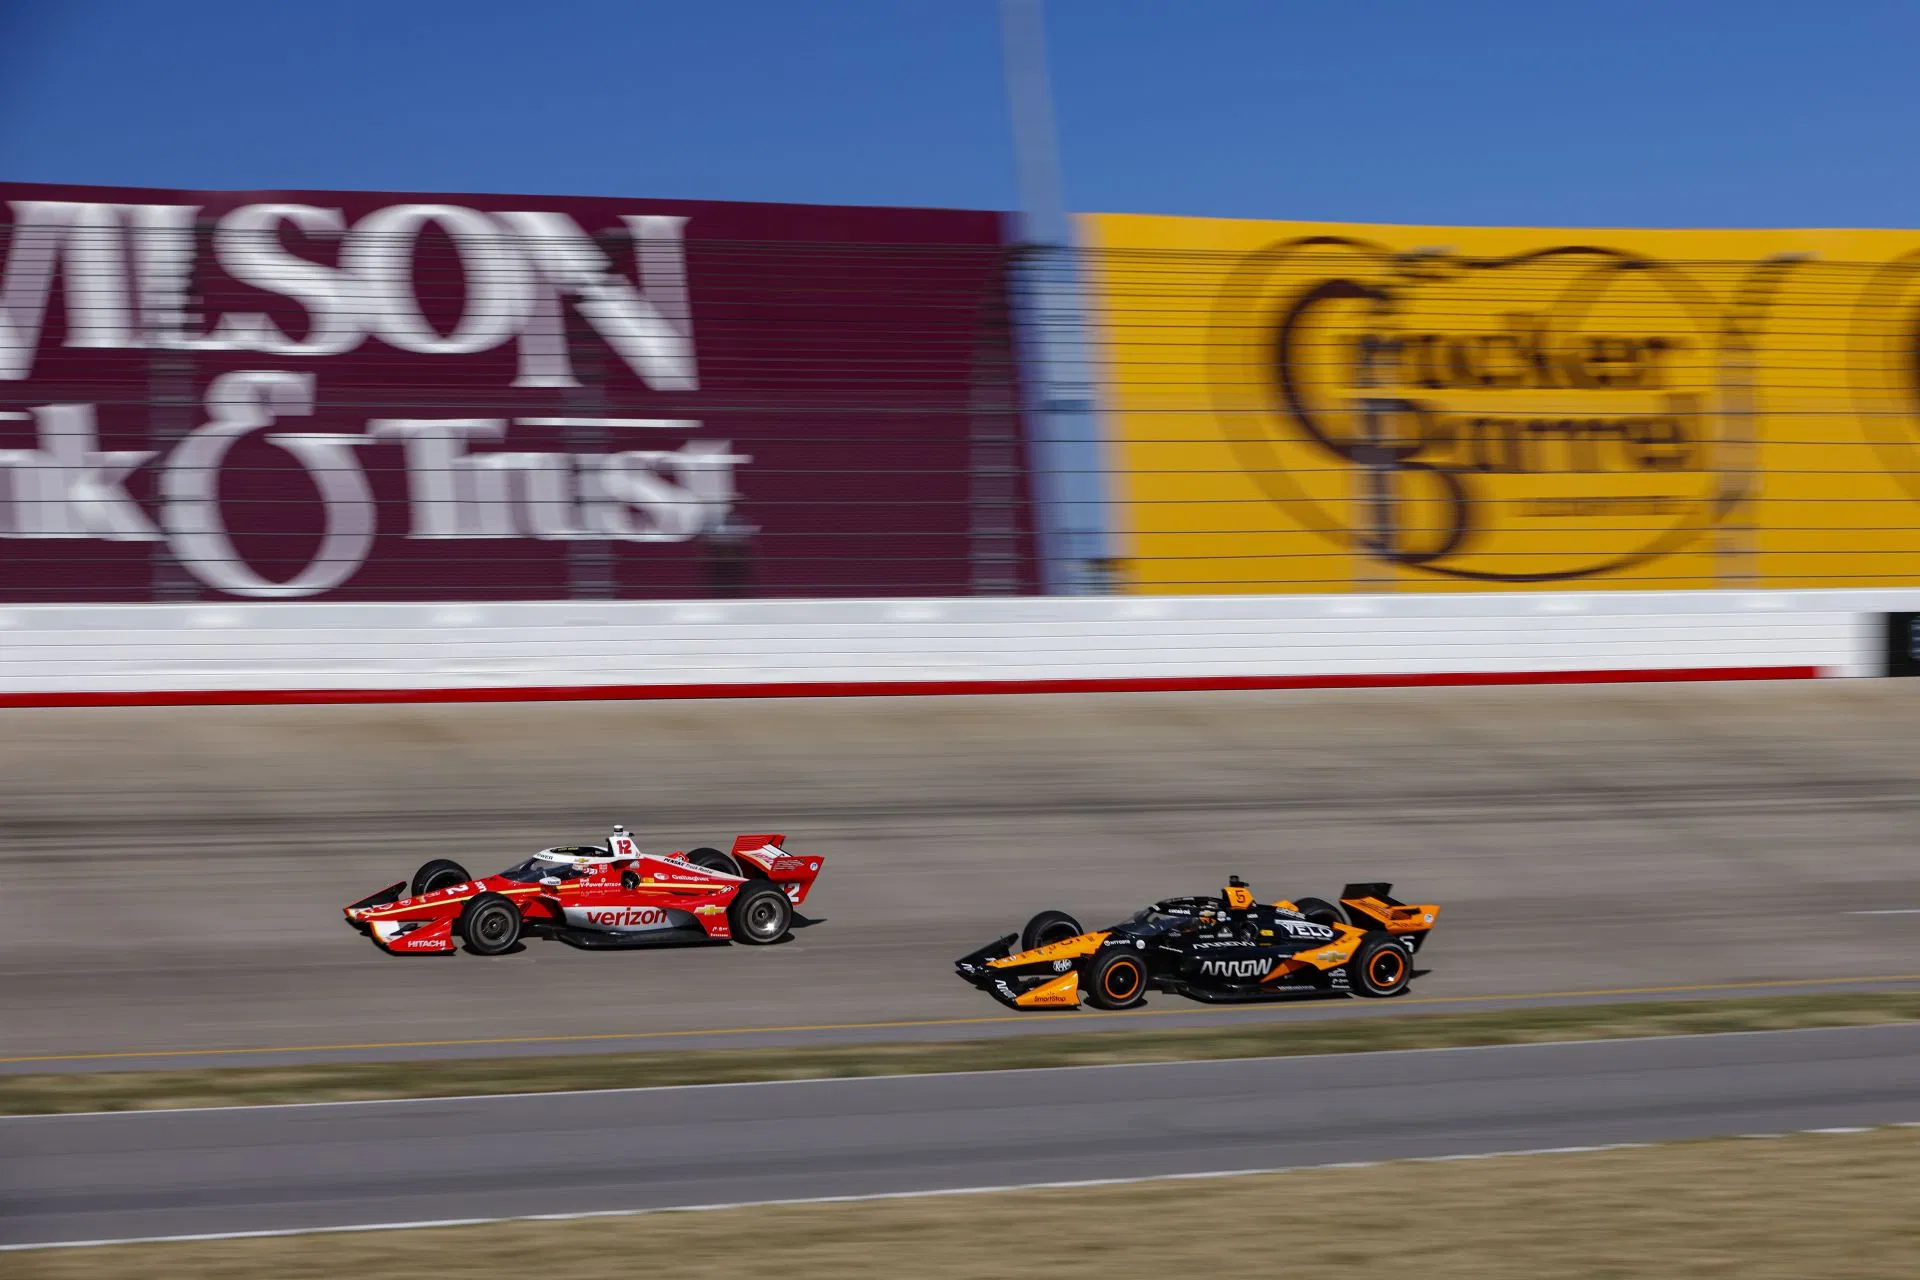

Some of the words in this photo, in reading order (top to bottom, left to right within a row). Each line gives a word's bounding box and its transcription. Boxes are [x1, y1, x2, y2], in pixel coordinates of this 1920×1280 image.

[159, 370, 377, 597] &
[365, 418, 752, 543] Trust
[616, 840, 632, 854] 12
[663, 857, 686, 867] PENSKE
[1235, 890, 1246, 904] 5
[586, 907, 668, 926] verizon
[1275, 919, 1334, 938] VELO
[407, 940, 447, 948] HITACHI
[1200, 957, 1273, 978] ARROW
[1033, 994, 1067, 1003] SmartStop
